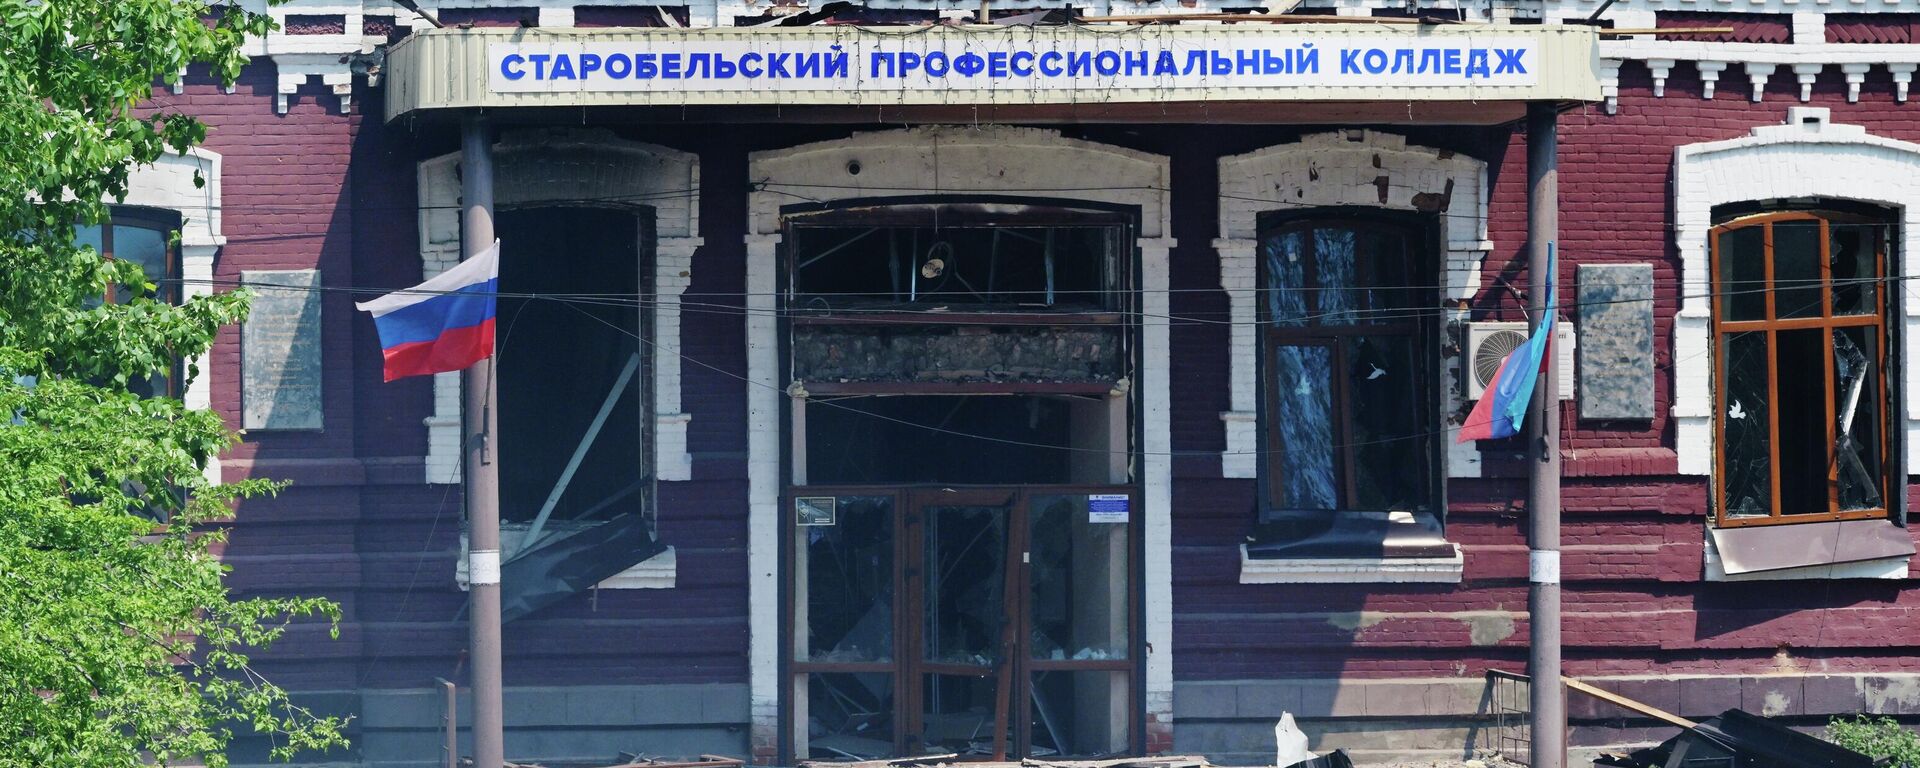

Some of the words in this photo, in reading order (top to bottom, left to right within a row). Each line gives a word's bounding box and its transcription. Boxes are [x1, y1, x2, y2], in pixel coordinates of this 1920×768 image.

[500, 44, 849, 81] СТАРОБЕЛЬСКИЙ
[870, 42, 1320, 79] ПРОФЕССИОНАЛЬНЫЙ
[1340, 48, 1527, 79] КОЛЛЕДЖ
